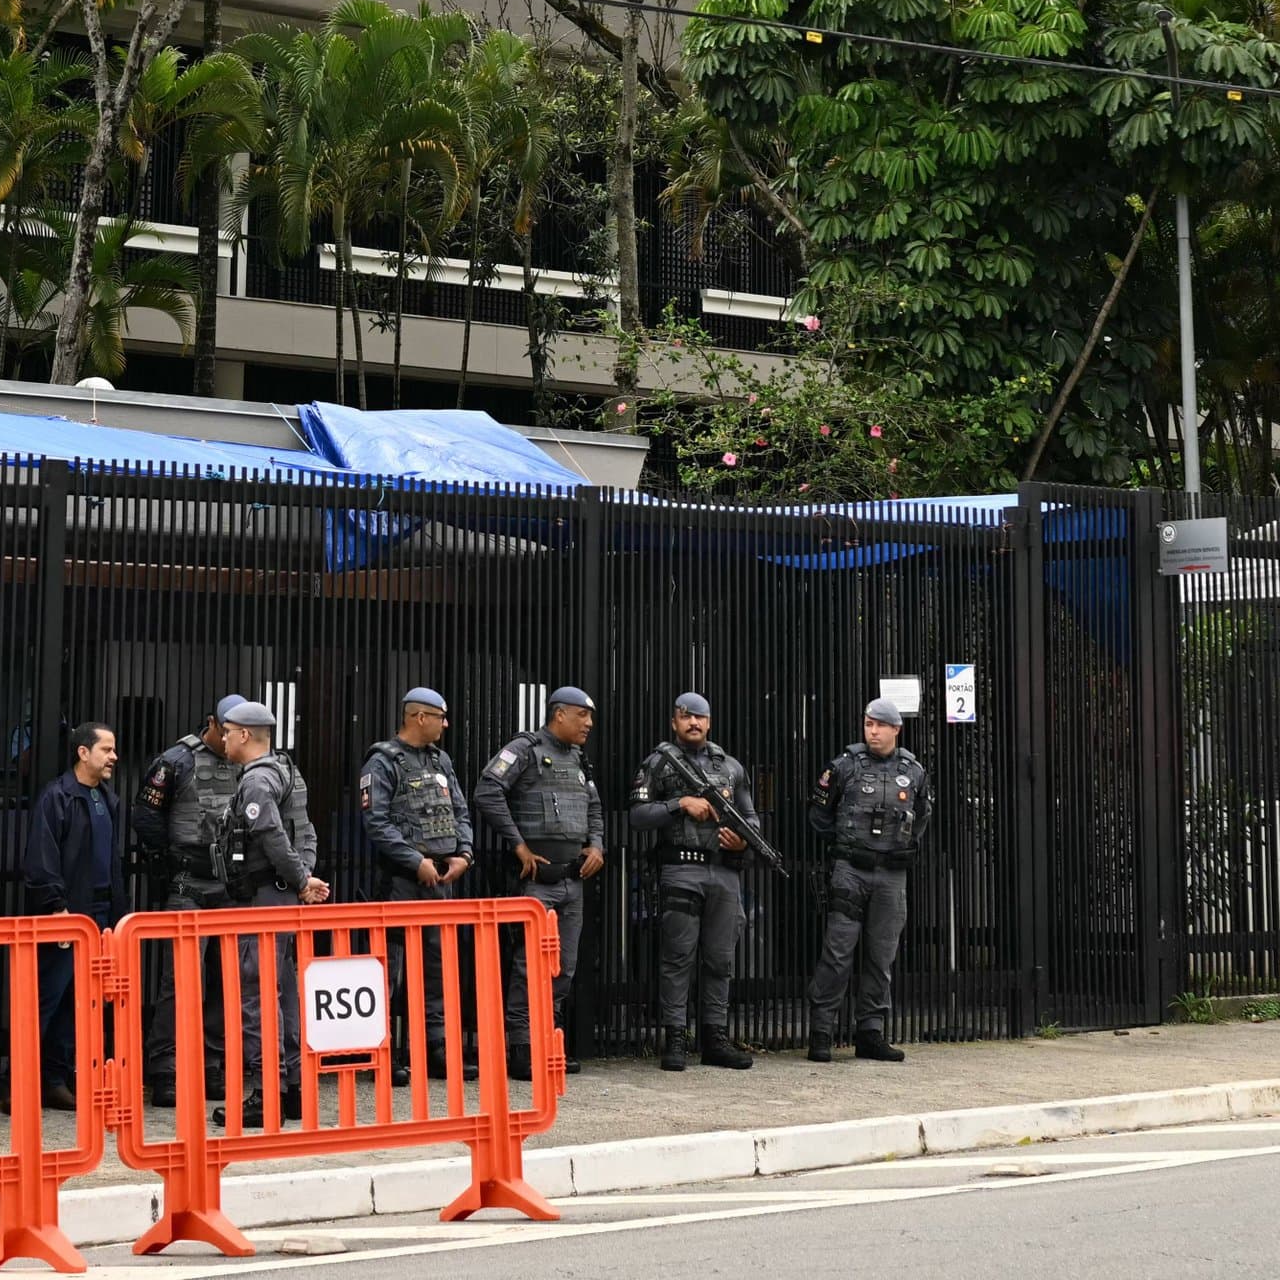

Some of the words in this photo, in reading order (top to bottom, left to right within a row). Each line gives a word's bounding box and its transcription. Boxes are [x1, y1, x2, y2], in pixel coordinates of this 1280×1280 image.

[948, 683, 973, 692] PORTÃO
[956, 697, 965, 713] 2
[314, 986, 376, 1021] RSO
